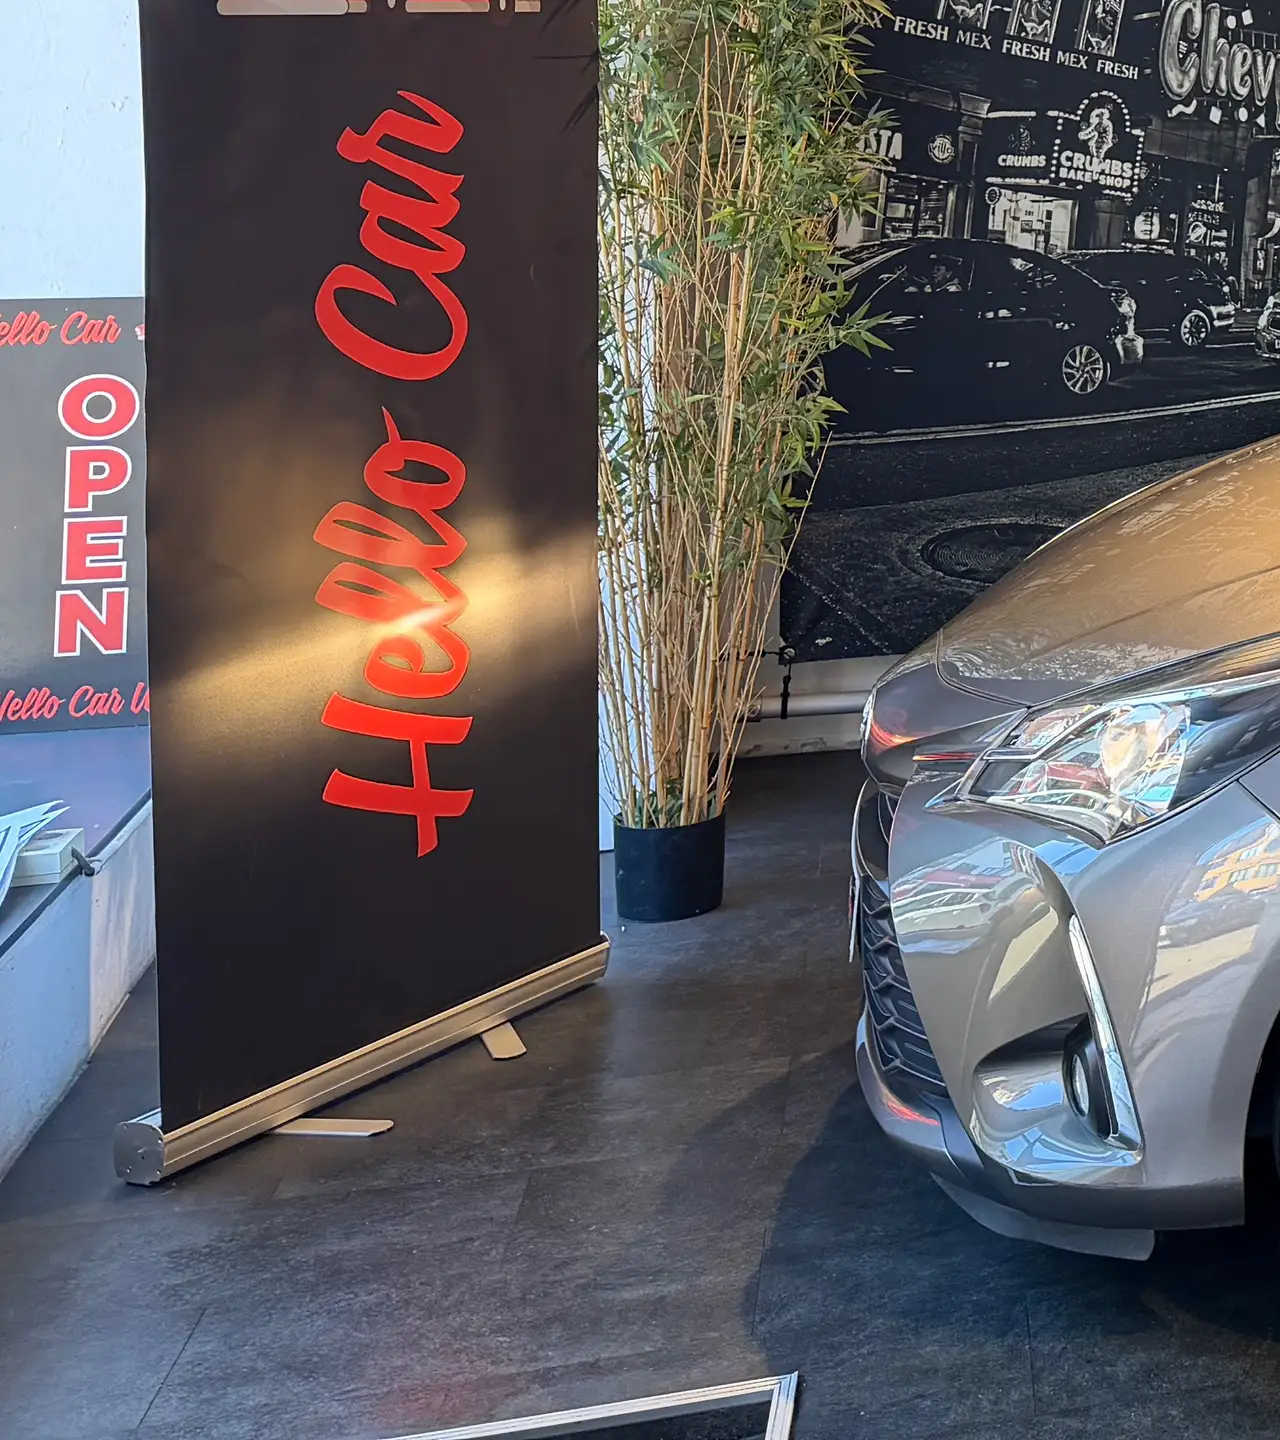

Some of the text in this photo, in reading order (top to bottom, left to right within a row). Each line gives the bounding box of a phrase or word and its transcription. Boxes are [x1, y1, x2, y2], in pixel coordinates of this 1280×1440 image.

[893, 15, 950, 42] FRESH
[955, 29, 993, 50] MEX
[1001, 38, 1051, 62] FRESH
[1056, 50, 1089, 70] MEX
[1096, 59, 1139, 80] FRESH
[997, 154, 1047, 168] CRUMBS
[1059, 149, 1134, 179] CRUMBS
[1098, 174, 1132, 190] SHOP
[0, 310, 121, 347] ello Car
[313, 89, 475, 859] Hello Car
[53, 372, 141, 658] OPEN
[68, 684, 125, 716] Car
